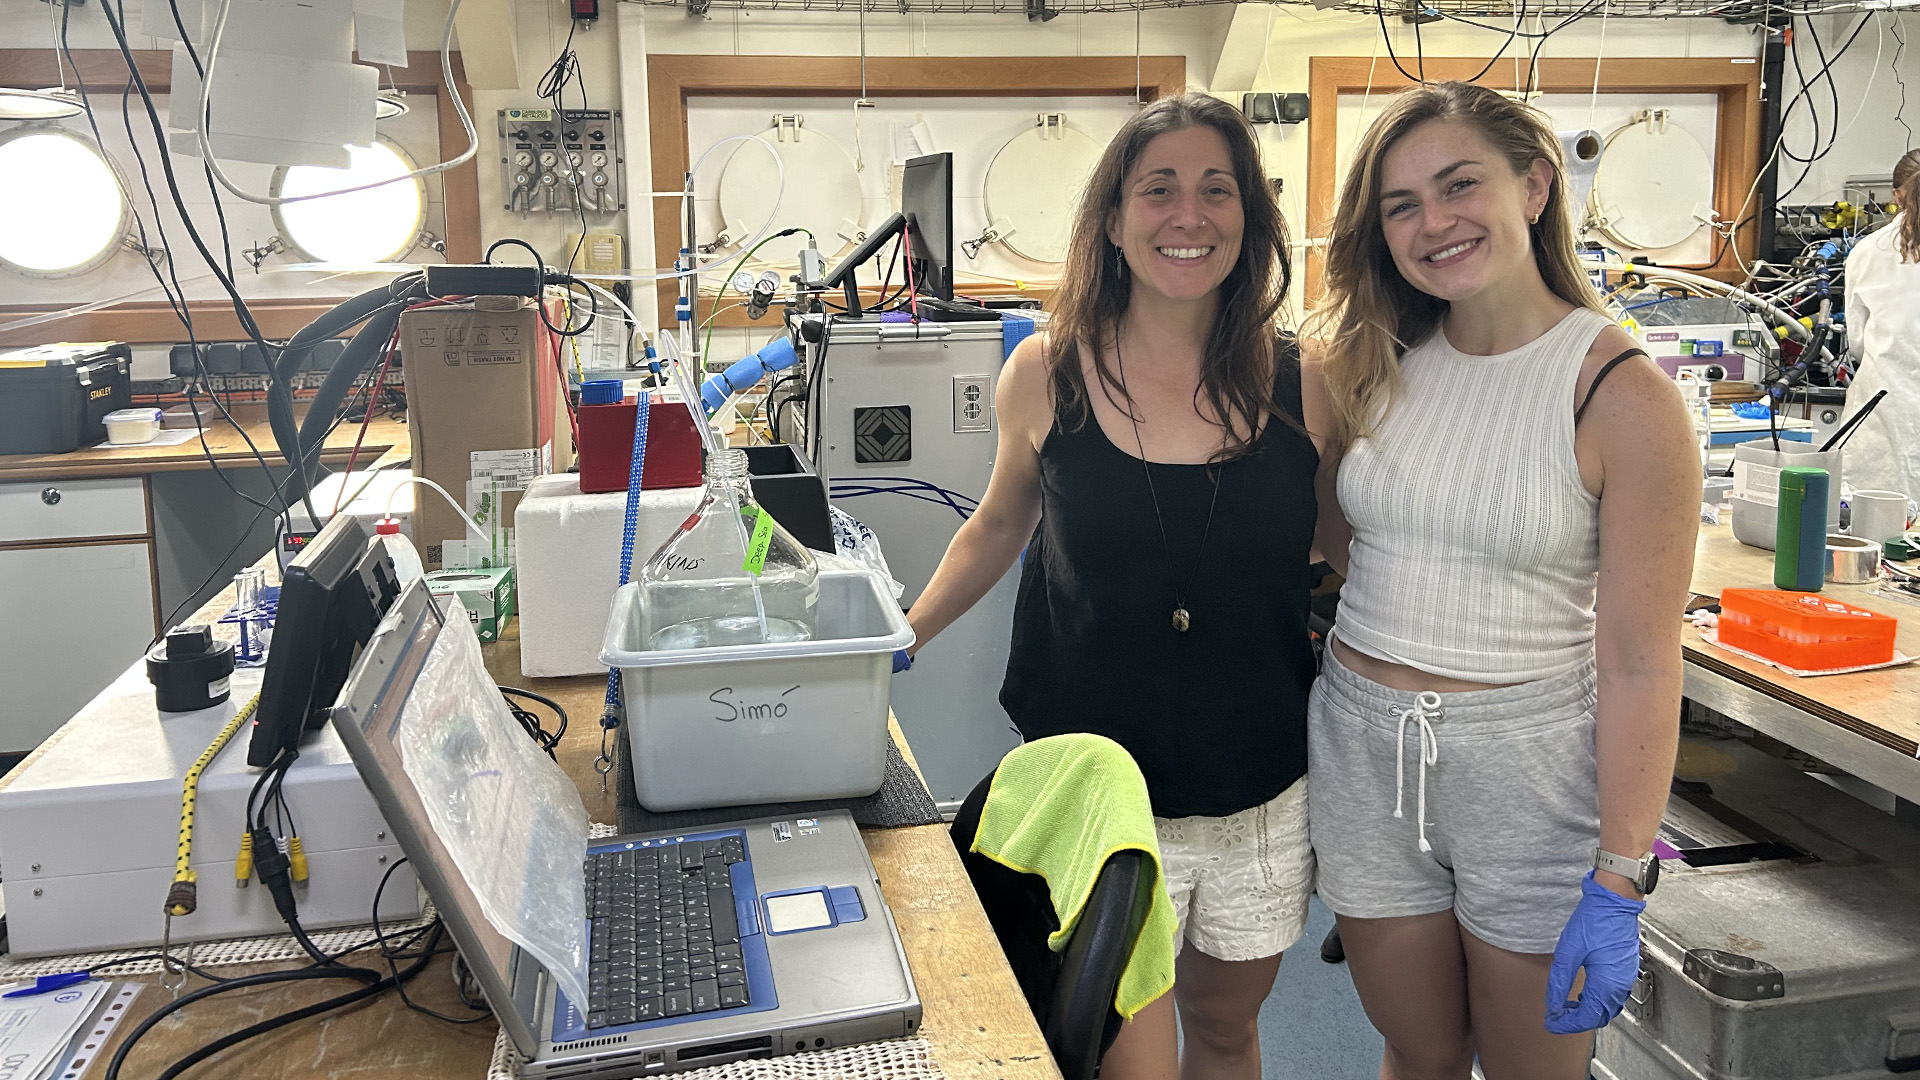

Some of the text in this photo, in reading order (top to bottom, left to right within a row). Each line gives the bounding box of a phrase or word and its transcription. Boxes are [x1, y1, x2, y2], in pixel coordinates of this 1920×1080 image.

[90, 386, 112, 400] STANLEY
[750, 541, 765, 564] Deep
[759, 526, 768, 539] Sea
[709, 685, 801, 722] Simó
